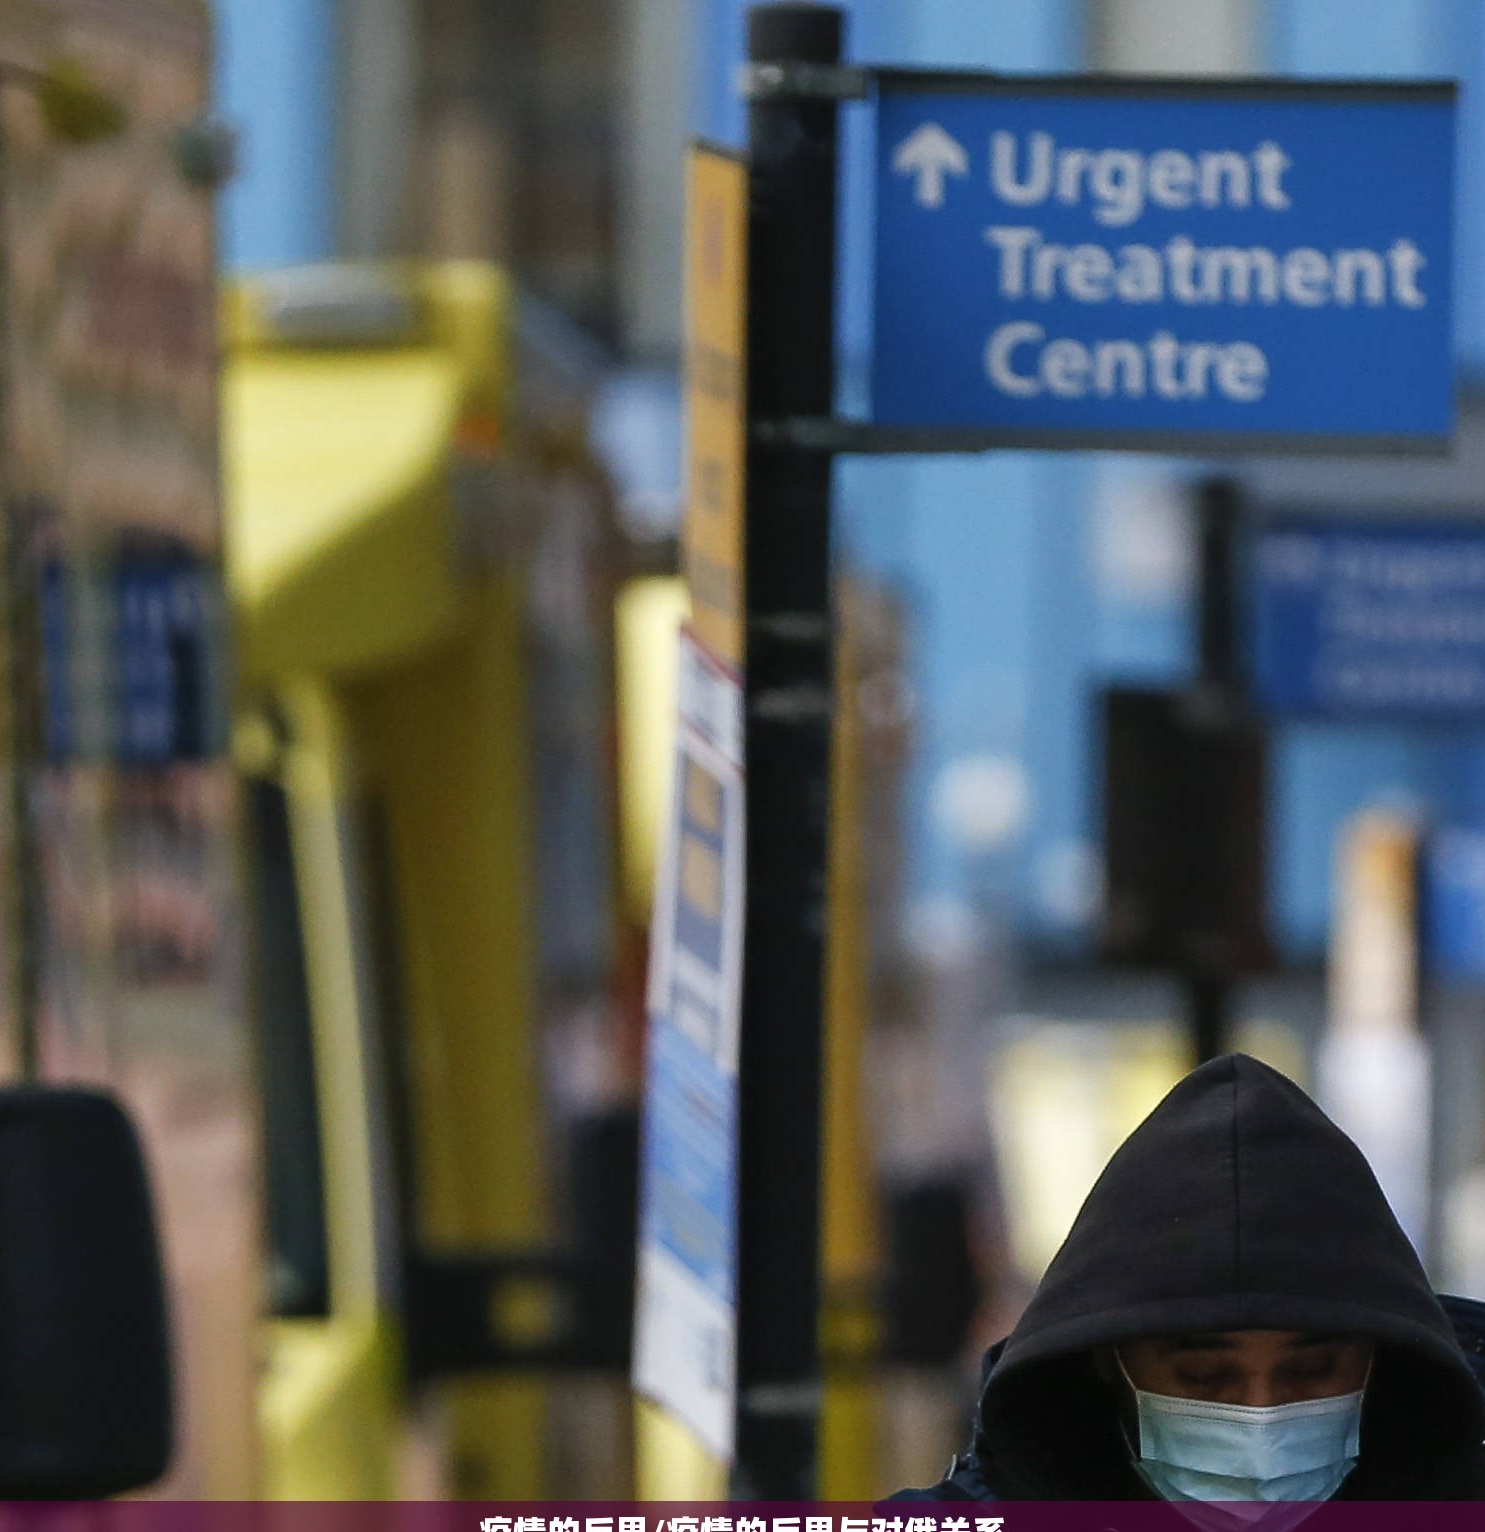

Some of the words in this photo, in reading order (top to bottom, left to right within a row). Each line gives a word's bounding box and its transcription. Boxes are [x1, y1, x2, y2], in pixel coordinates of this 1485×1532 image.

[989, 129, 1293, 228] Urgent
[984, 225, 1427, 310] Treatment
[983, 320, 1269, 403] Centre
